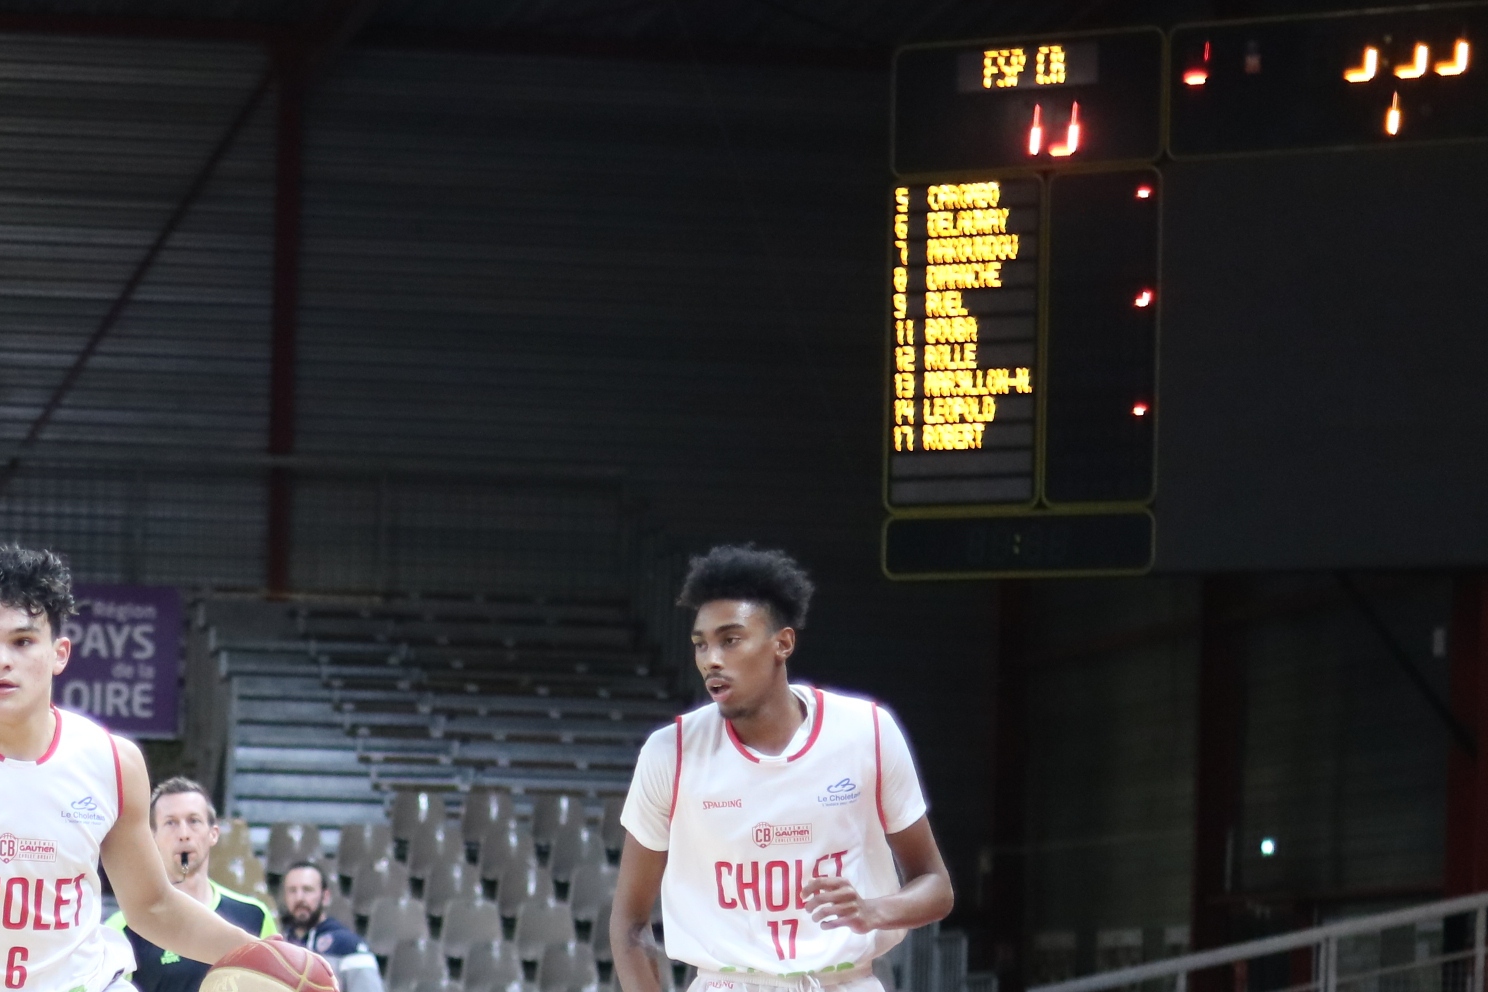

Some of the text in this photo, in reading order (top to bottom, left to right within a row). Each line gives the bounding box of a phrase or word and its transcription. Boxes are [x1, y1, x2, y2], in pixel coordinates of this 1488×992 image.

[895, 319, 914, 345] 11
[895, 345, 915, 371] 12
[63, 623, 155, 659] PAYS
[63, 682, 155, 718] OIRE
[702, 798, 742, 810] SPALDING
[0, 839, 15, 857] CB
[755, 828, 771, 843] CB
[767, 919, 799, 960] 17
[4, 946, 29, 989] 6
